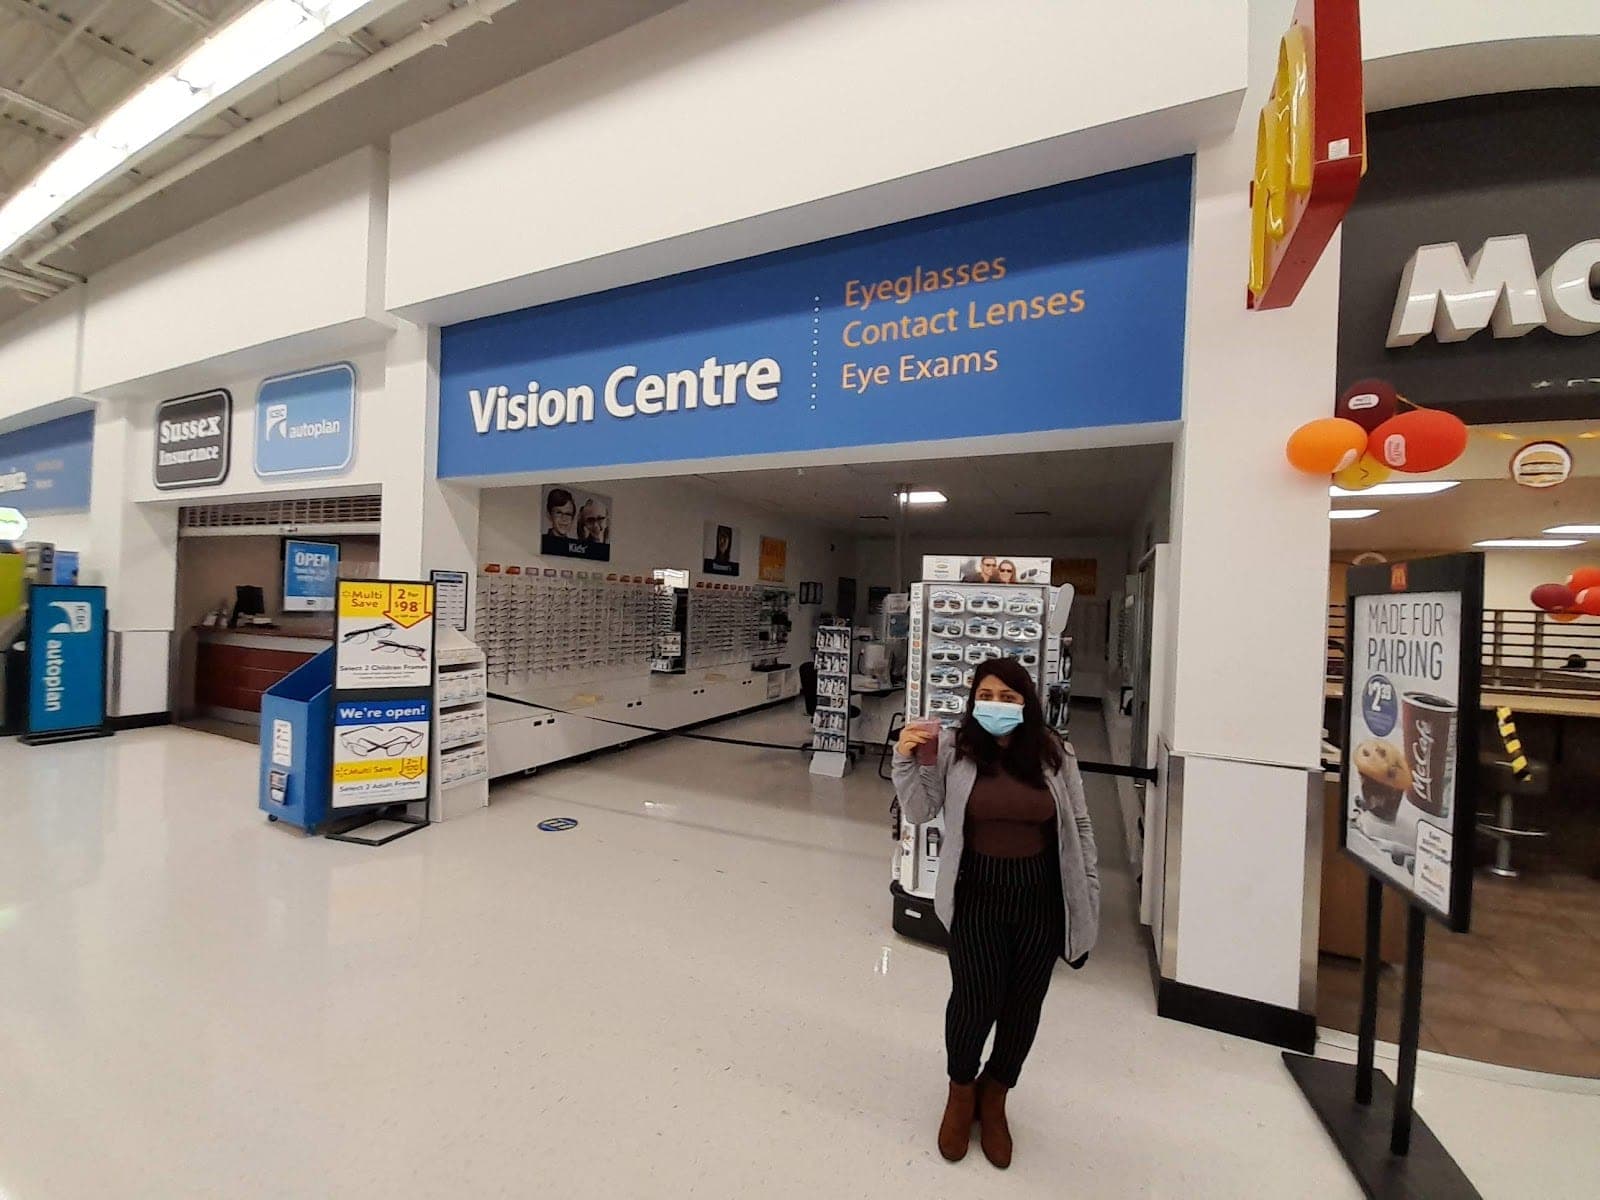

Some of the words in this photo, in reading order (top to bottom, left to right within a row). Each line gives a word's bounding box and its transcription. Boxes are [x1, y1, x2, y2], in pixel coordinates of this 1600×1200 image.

[845, 256, 1007, 309] Eyeglasses
[842, 309, 963, 350] Contact
[968, 288, 1086, 330] Lenses
[841, 362, 891, 391] Eye
[899, 349, 998, 384] Exams
[469, 380, 595, 434] Vision
[604, 357, 782, 418] Centre
[160, 415, 221, 444] Sussex
[289, 420, 340, 439] autoplan
[158, 445, 219, 466] Insurance
[295, 551, 330, 567] OPEN
[351, 598, 379, 608] Save
[352, 590, 382, 599] Multi
[397, 588, 406, 599] 2
[1368, 602, 1408, 635] MADE
[1413, 602, 1444, 636] FOR
[1367, 637, 1443, 681] PAIRING
[42, 639, 65, 711] autoplan
[340, 707, 382, 719] We're
[385, 704, 426, 720] open!
